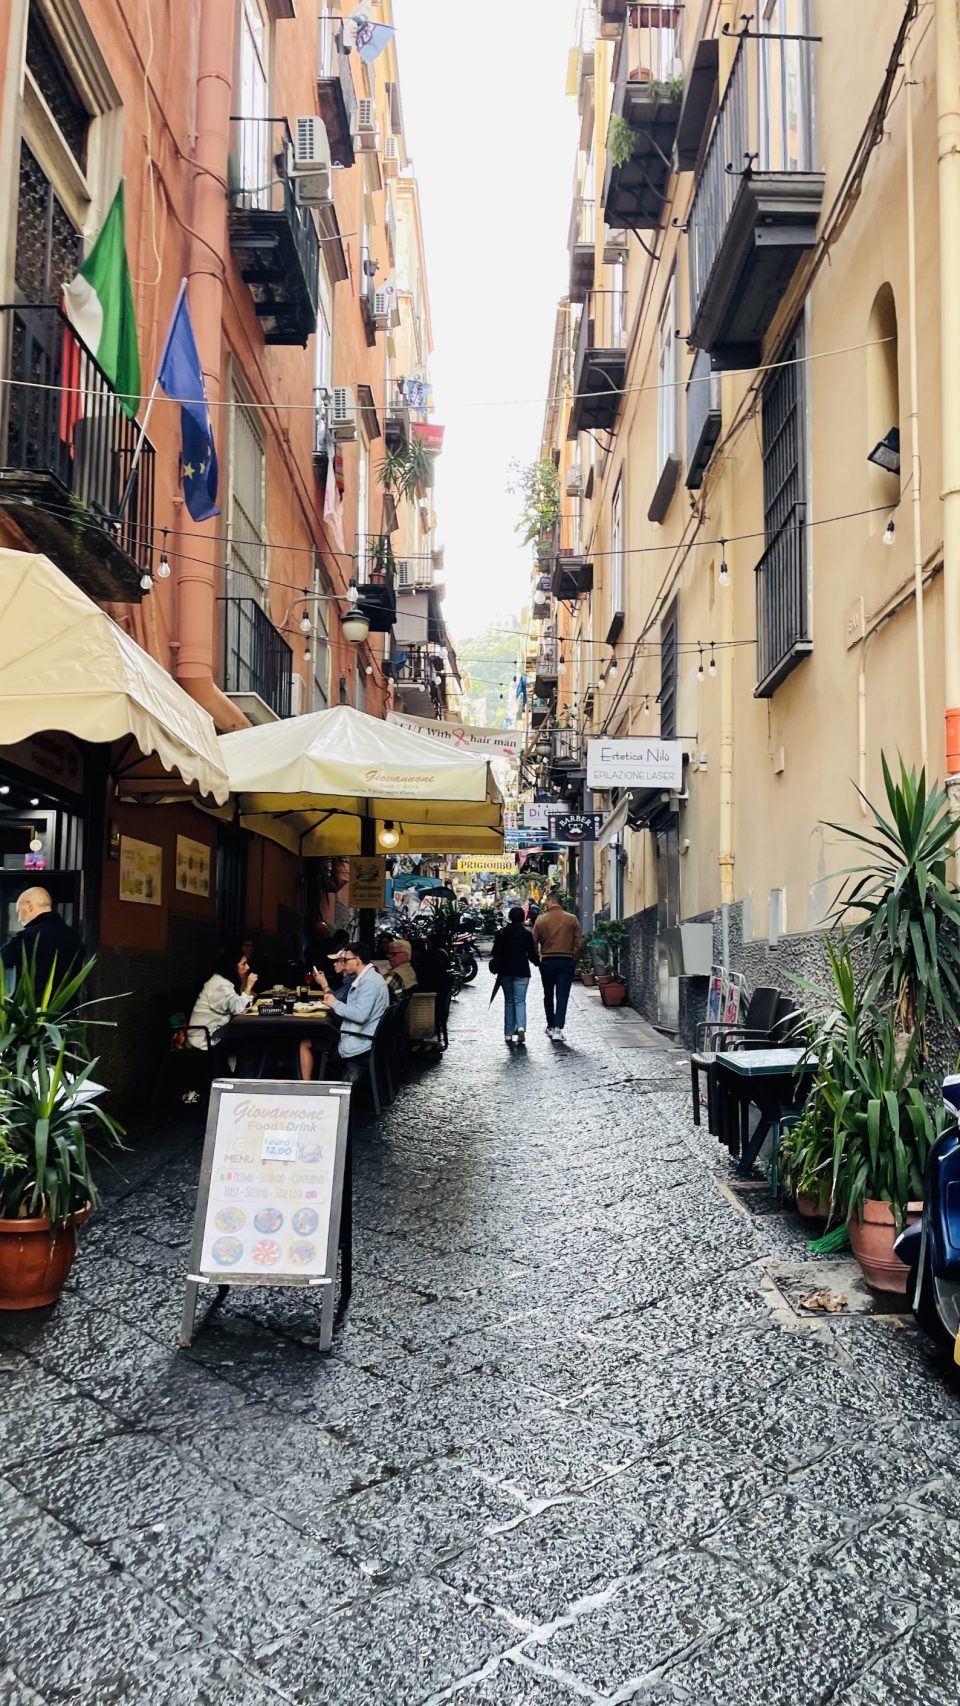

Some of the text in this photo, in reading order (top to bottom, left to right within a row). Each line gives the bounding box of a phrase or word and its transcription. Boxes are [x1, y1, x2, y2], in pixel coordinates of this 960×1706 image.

[426, 727, 452, 739] With
[470, 734, 491, 745] hair
[493, 738, 517, 748] man
[600, 747, 643, 761] Estetica
[364, 769, 435, 783] Giovannone
[593, 770, 675, 781] EPILAZIONE LASER
[559, 815, 592, 827] BARBER
[232, 1099, 326, 1124] Giovannone
[248, 1120, 277, 1131] Food
[286, 1121, 319, 1133] Drink
[224, 1153, 254, 1164] MENU
